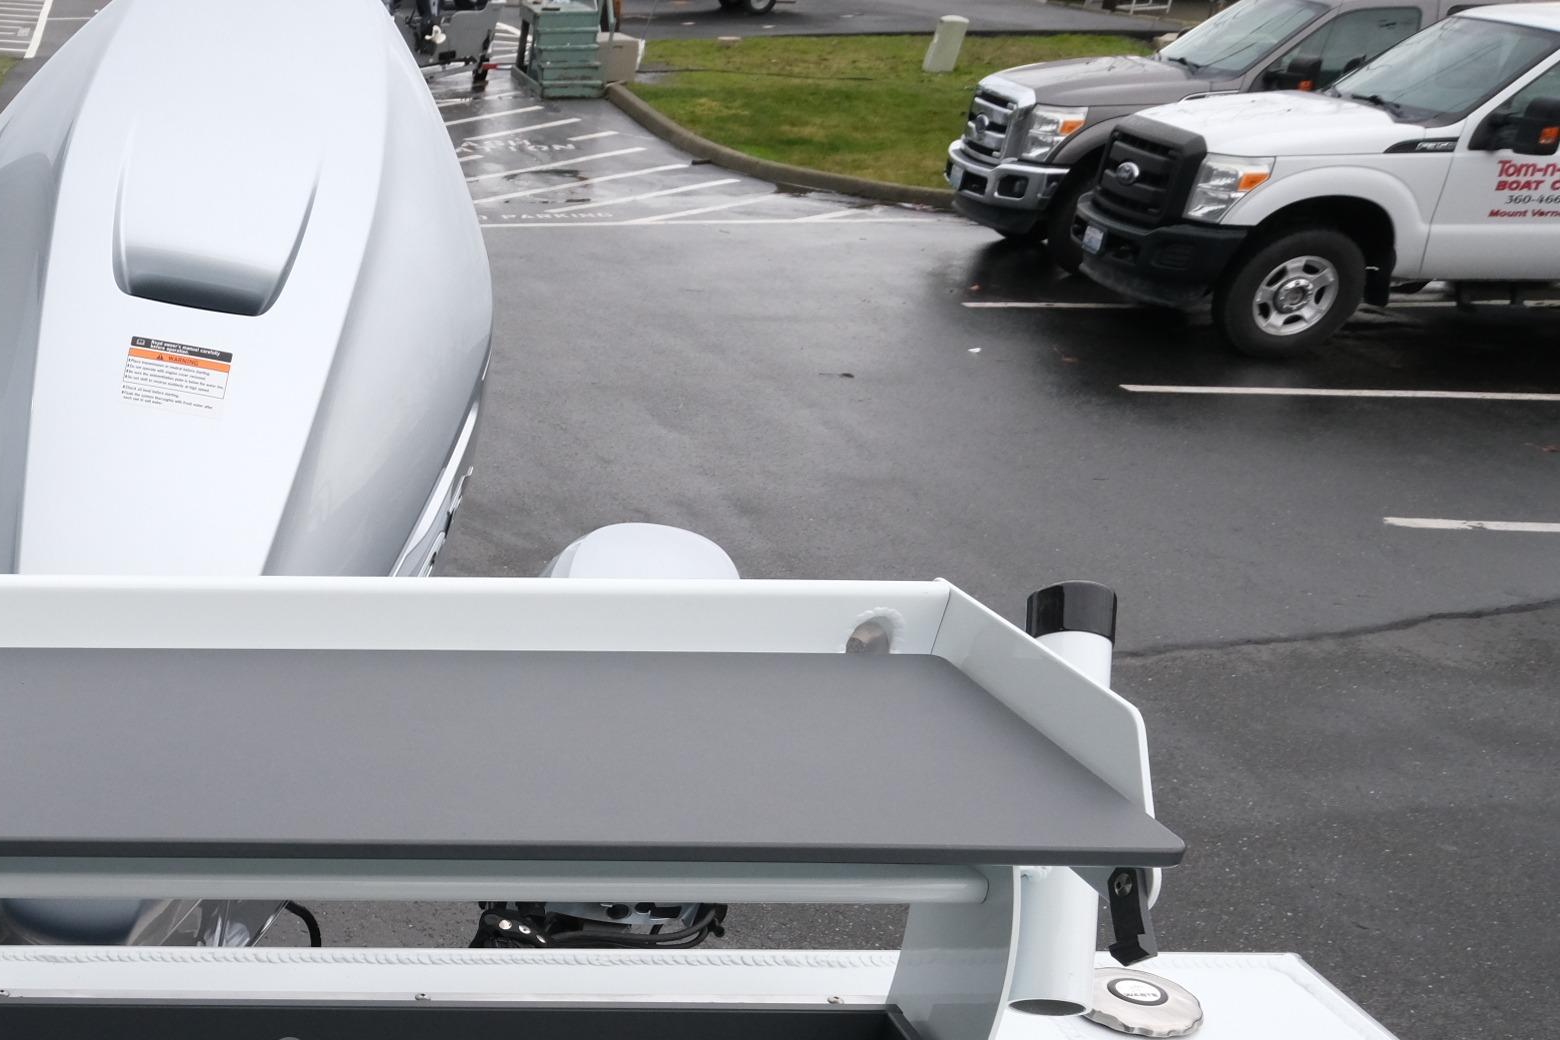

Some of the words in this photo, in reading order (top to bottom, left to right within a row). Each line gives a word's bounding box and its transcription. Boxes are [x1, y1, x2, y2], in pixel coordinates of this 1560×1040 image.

[1495, 180, 1545, 191] BOAT
[502, 212, 613, 220] PARKING
[1488, 209, 1528, 217] Mount
[168, 356, 199, 367] WARNING
